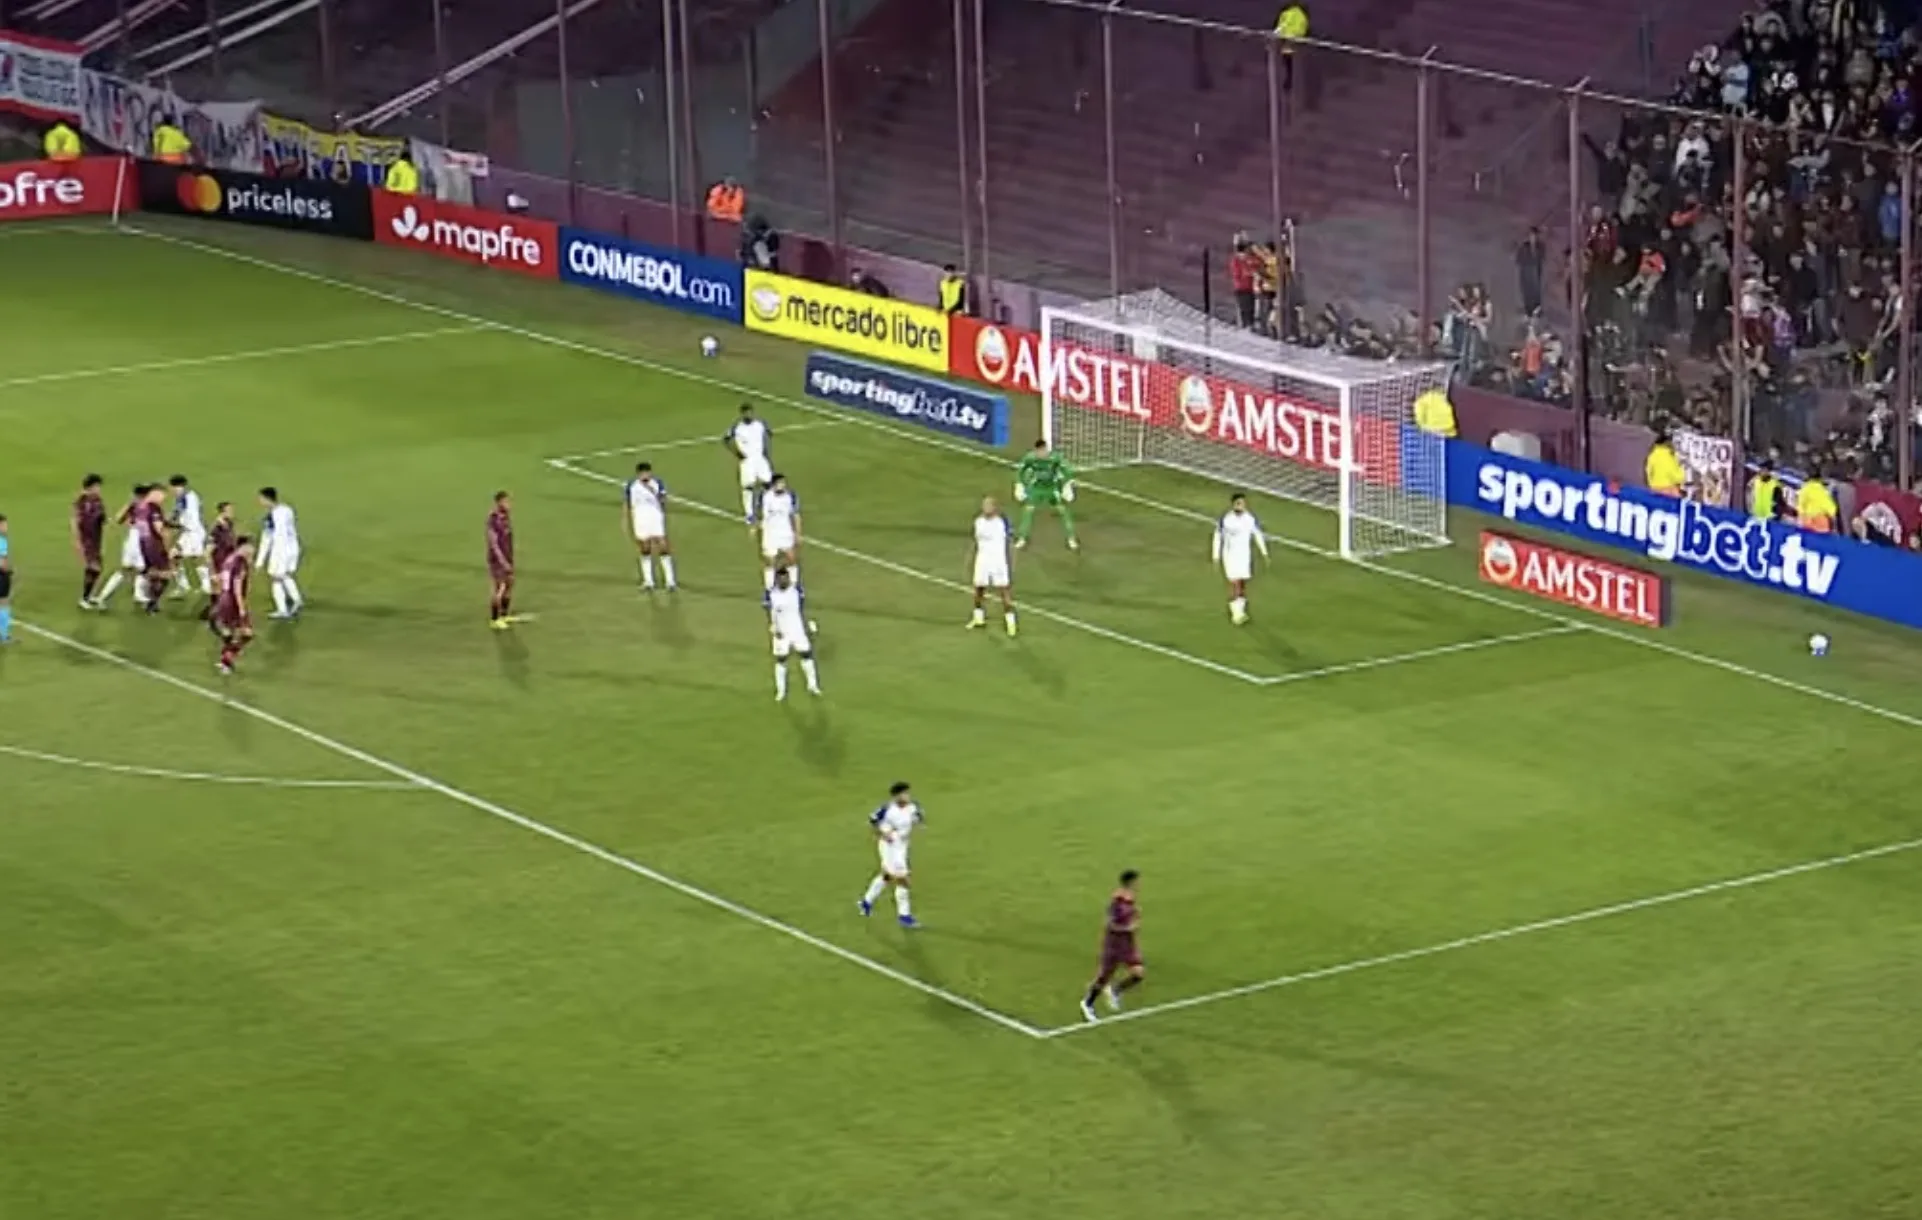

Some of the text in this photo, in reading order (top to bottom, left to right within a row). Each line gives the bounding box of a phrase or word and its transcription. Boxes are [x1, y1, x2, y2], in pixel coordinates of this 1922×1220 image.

[228, 184, 333, 219] priceless
[433, 218, 542, 266] mapfre
[786, 295, 942, 352] mercado libre
[1478, 463, 1839, 594] sportingbet.tv
[1522, 551, 1655, 622] AMSTEL
